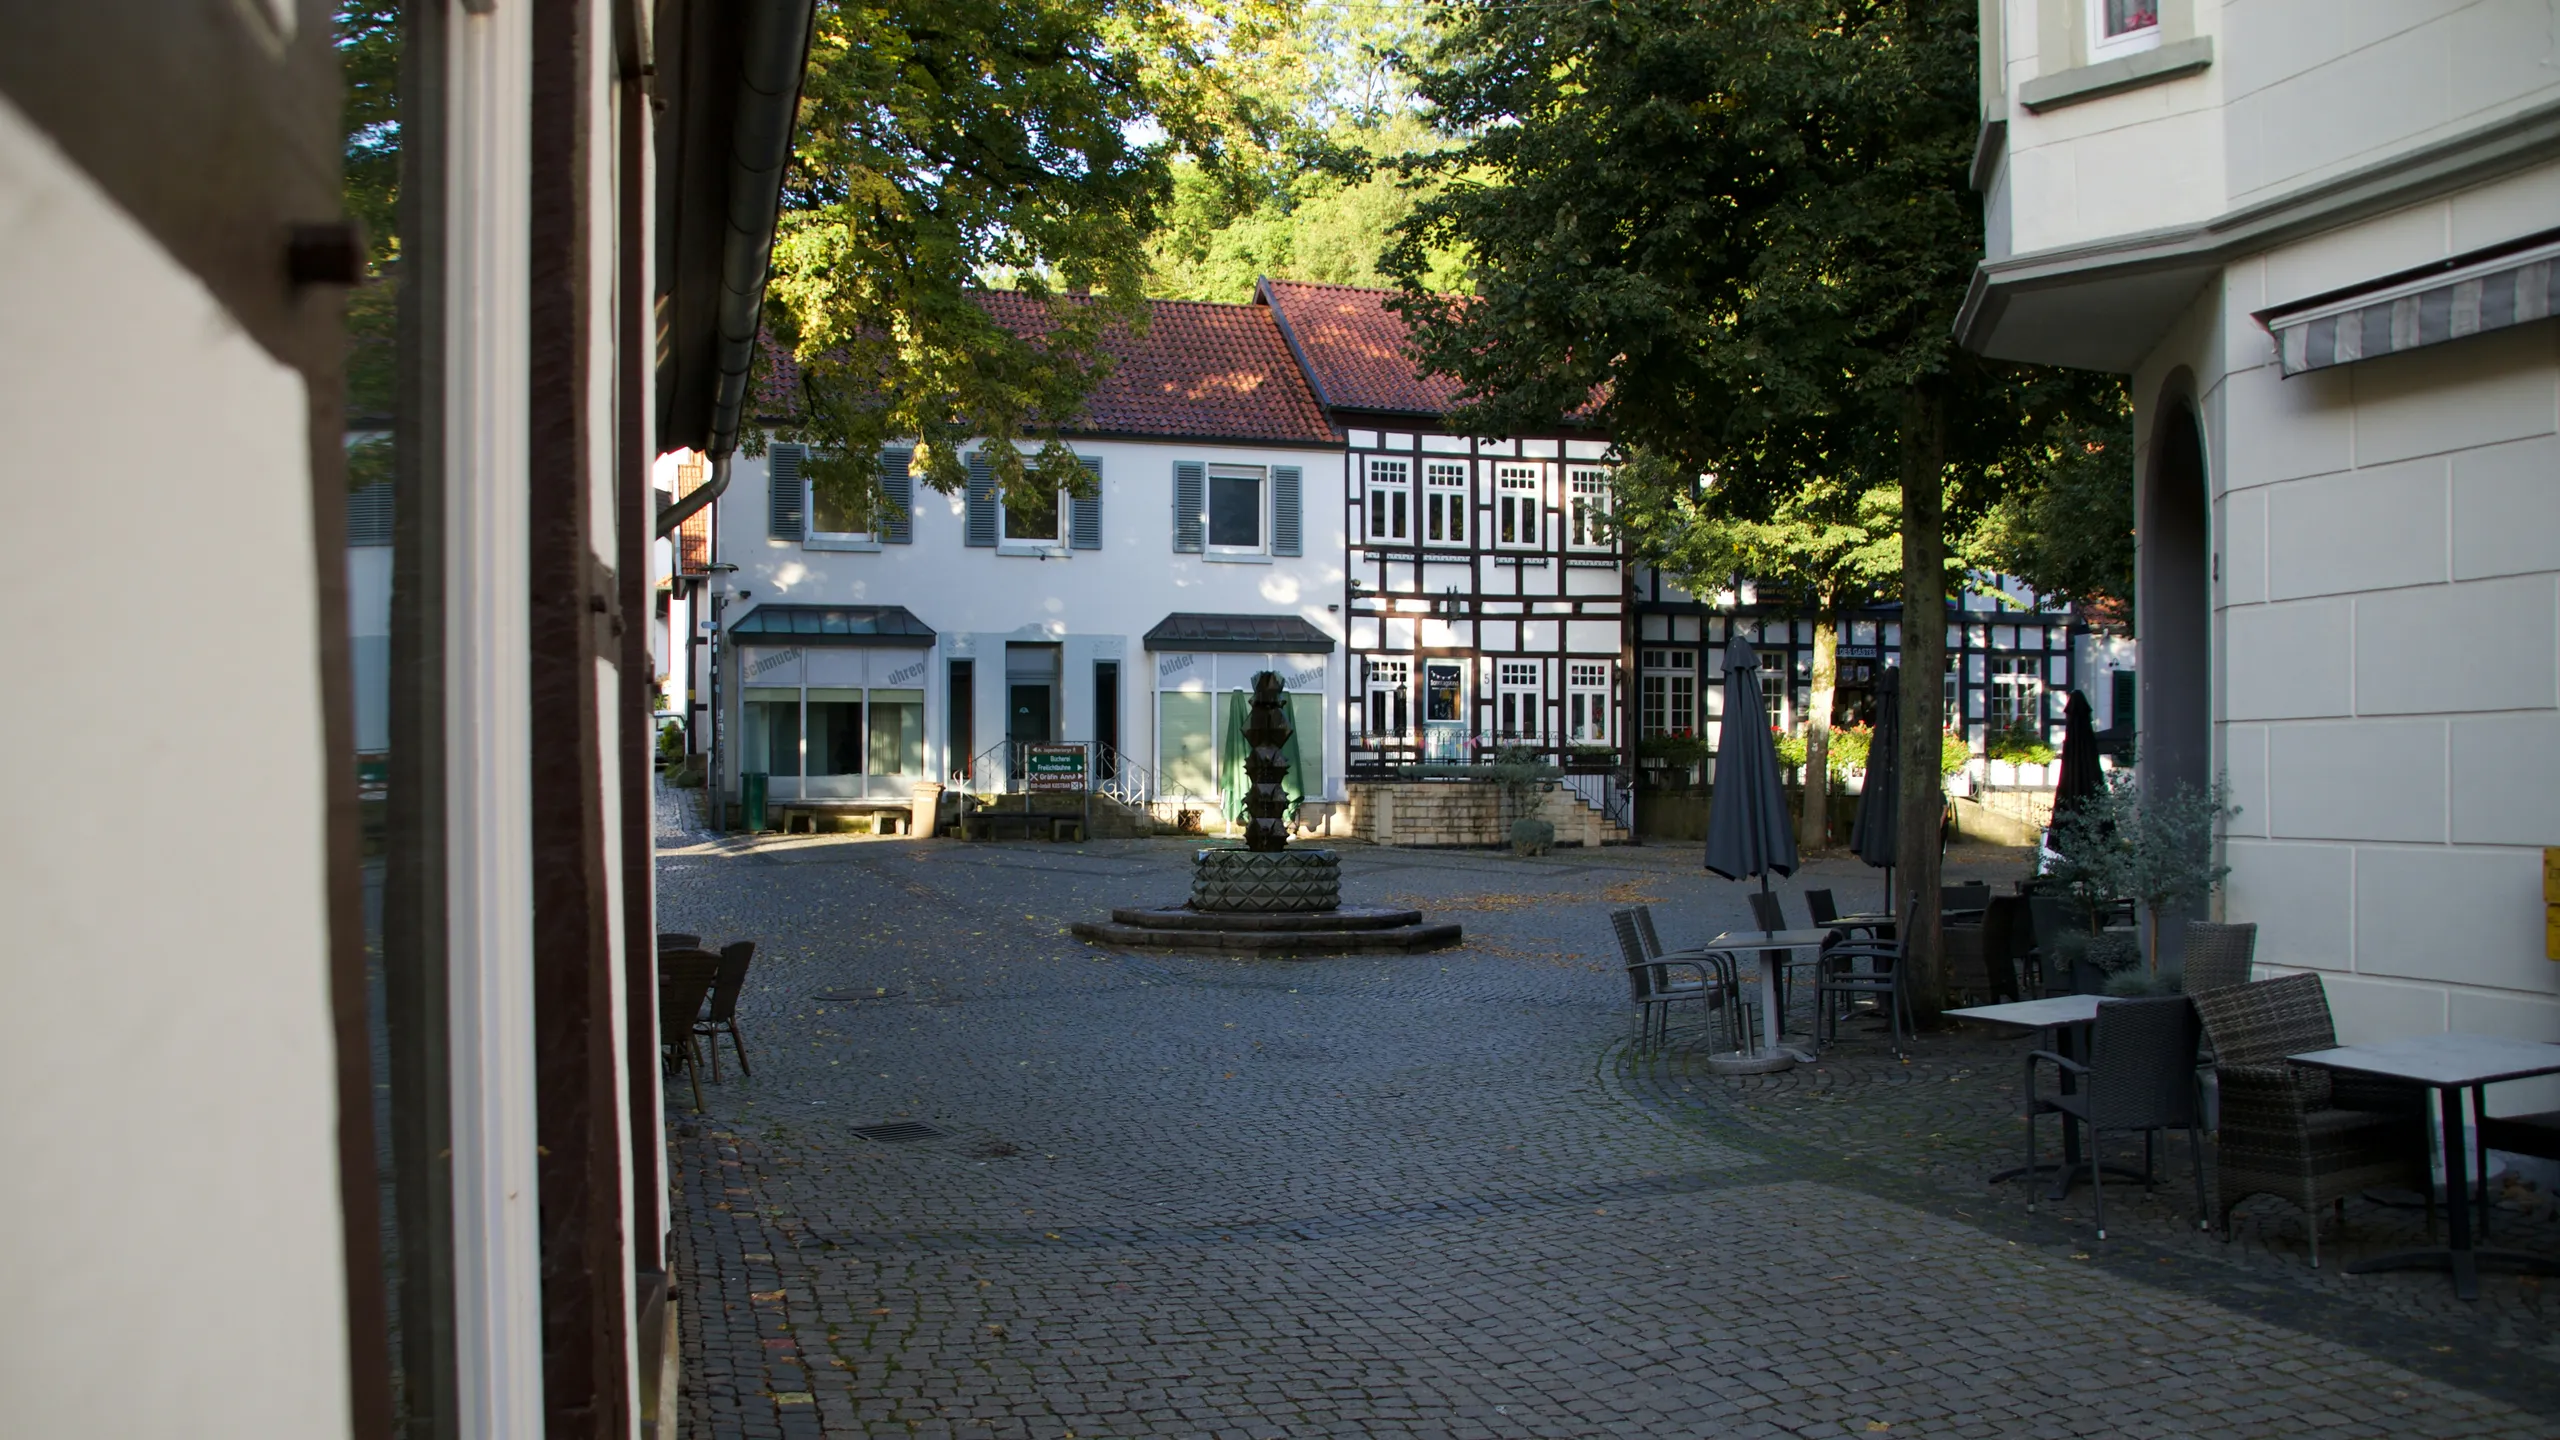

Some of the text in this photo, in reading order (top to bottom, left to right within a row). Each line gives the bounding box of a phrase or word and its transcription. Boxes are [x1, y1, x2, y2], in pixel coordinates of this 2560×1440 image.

[743, 647, 801, 679] schmuck
[888, 662, 925, 685] uhren
[1160, 654, 1194, 676] bilder
[1484, 673, 1490, 685] 5
